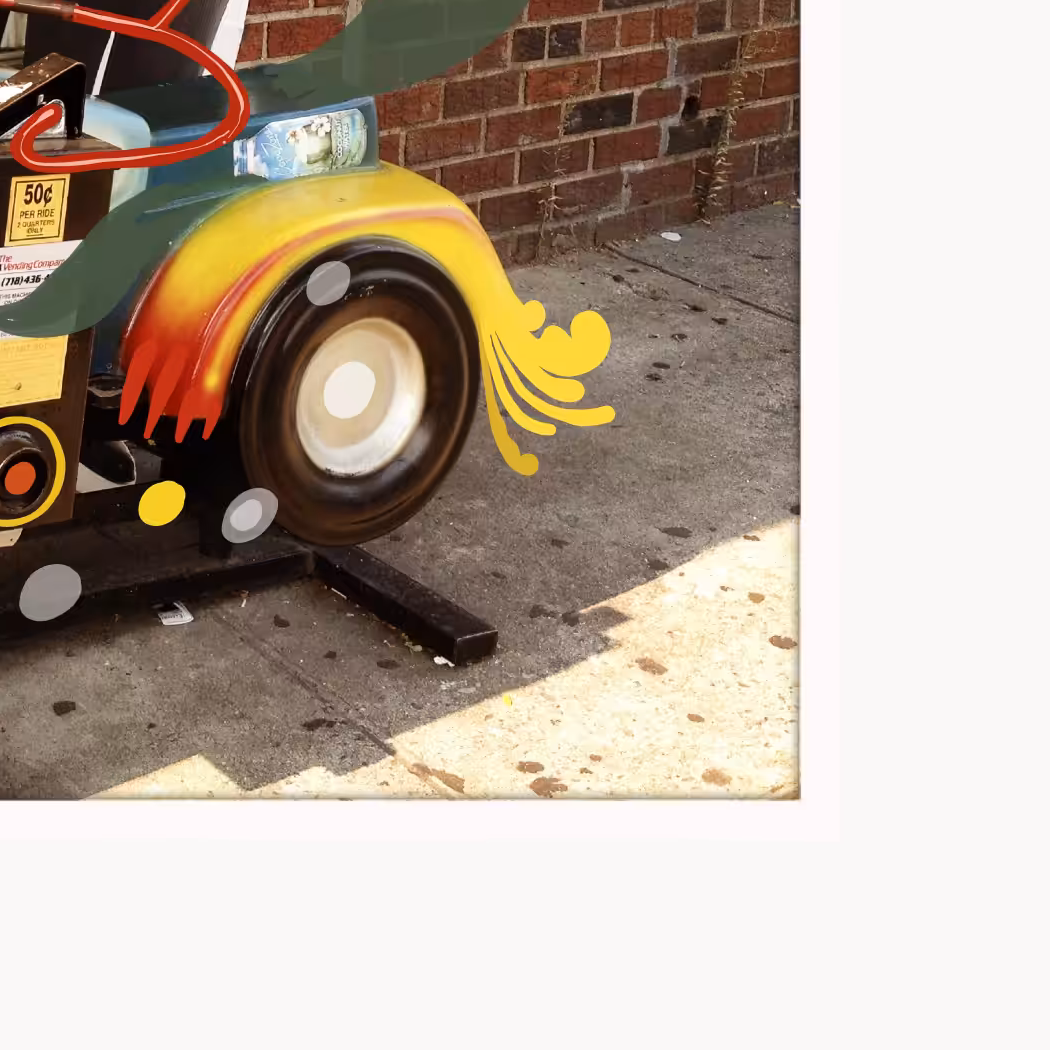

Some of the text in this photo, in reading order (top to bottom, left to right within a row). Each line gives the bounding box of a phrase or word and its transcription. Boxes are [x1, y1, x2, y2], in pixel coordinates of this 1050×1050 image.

[24, 182, 53, 207] 50¢
[20, 208, 55, 219] PER RIDE
[22, 219, 55, 228] QUARTERS
[0, 255, 12, 263] The
[3, 258, 66, 271] Vending Compan
[0, 292, 11, 300] THIS
